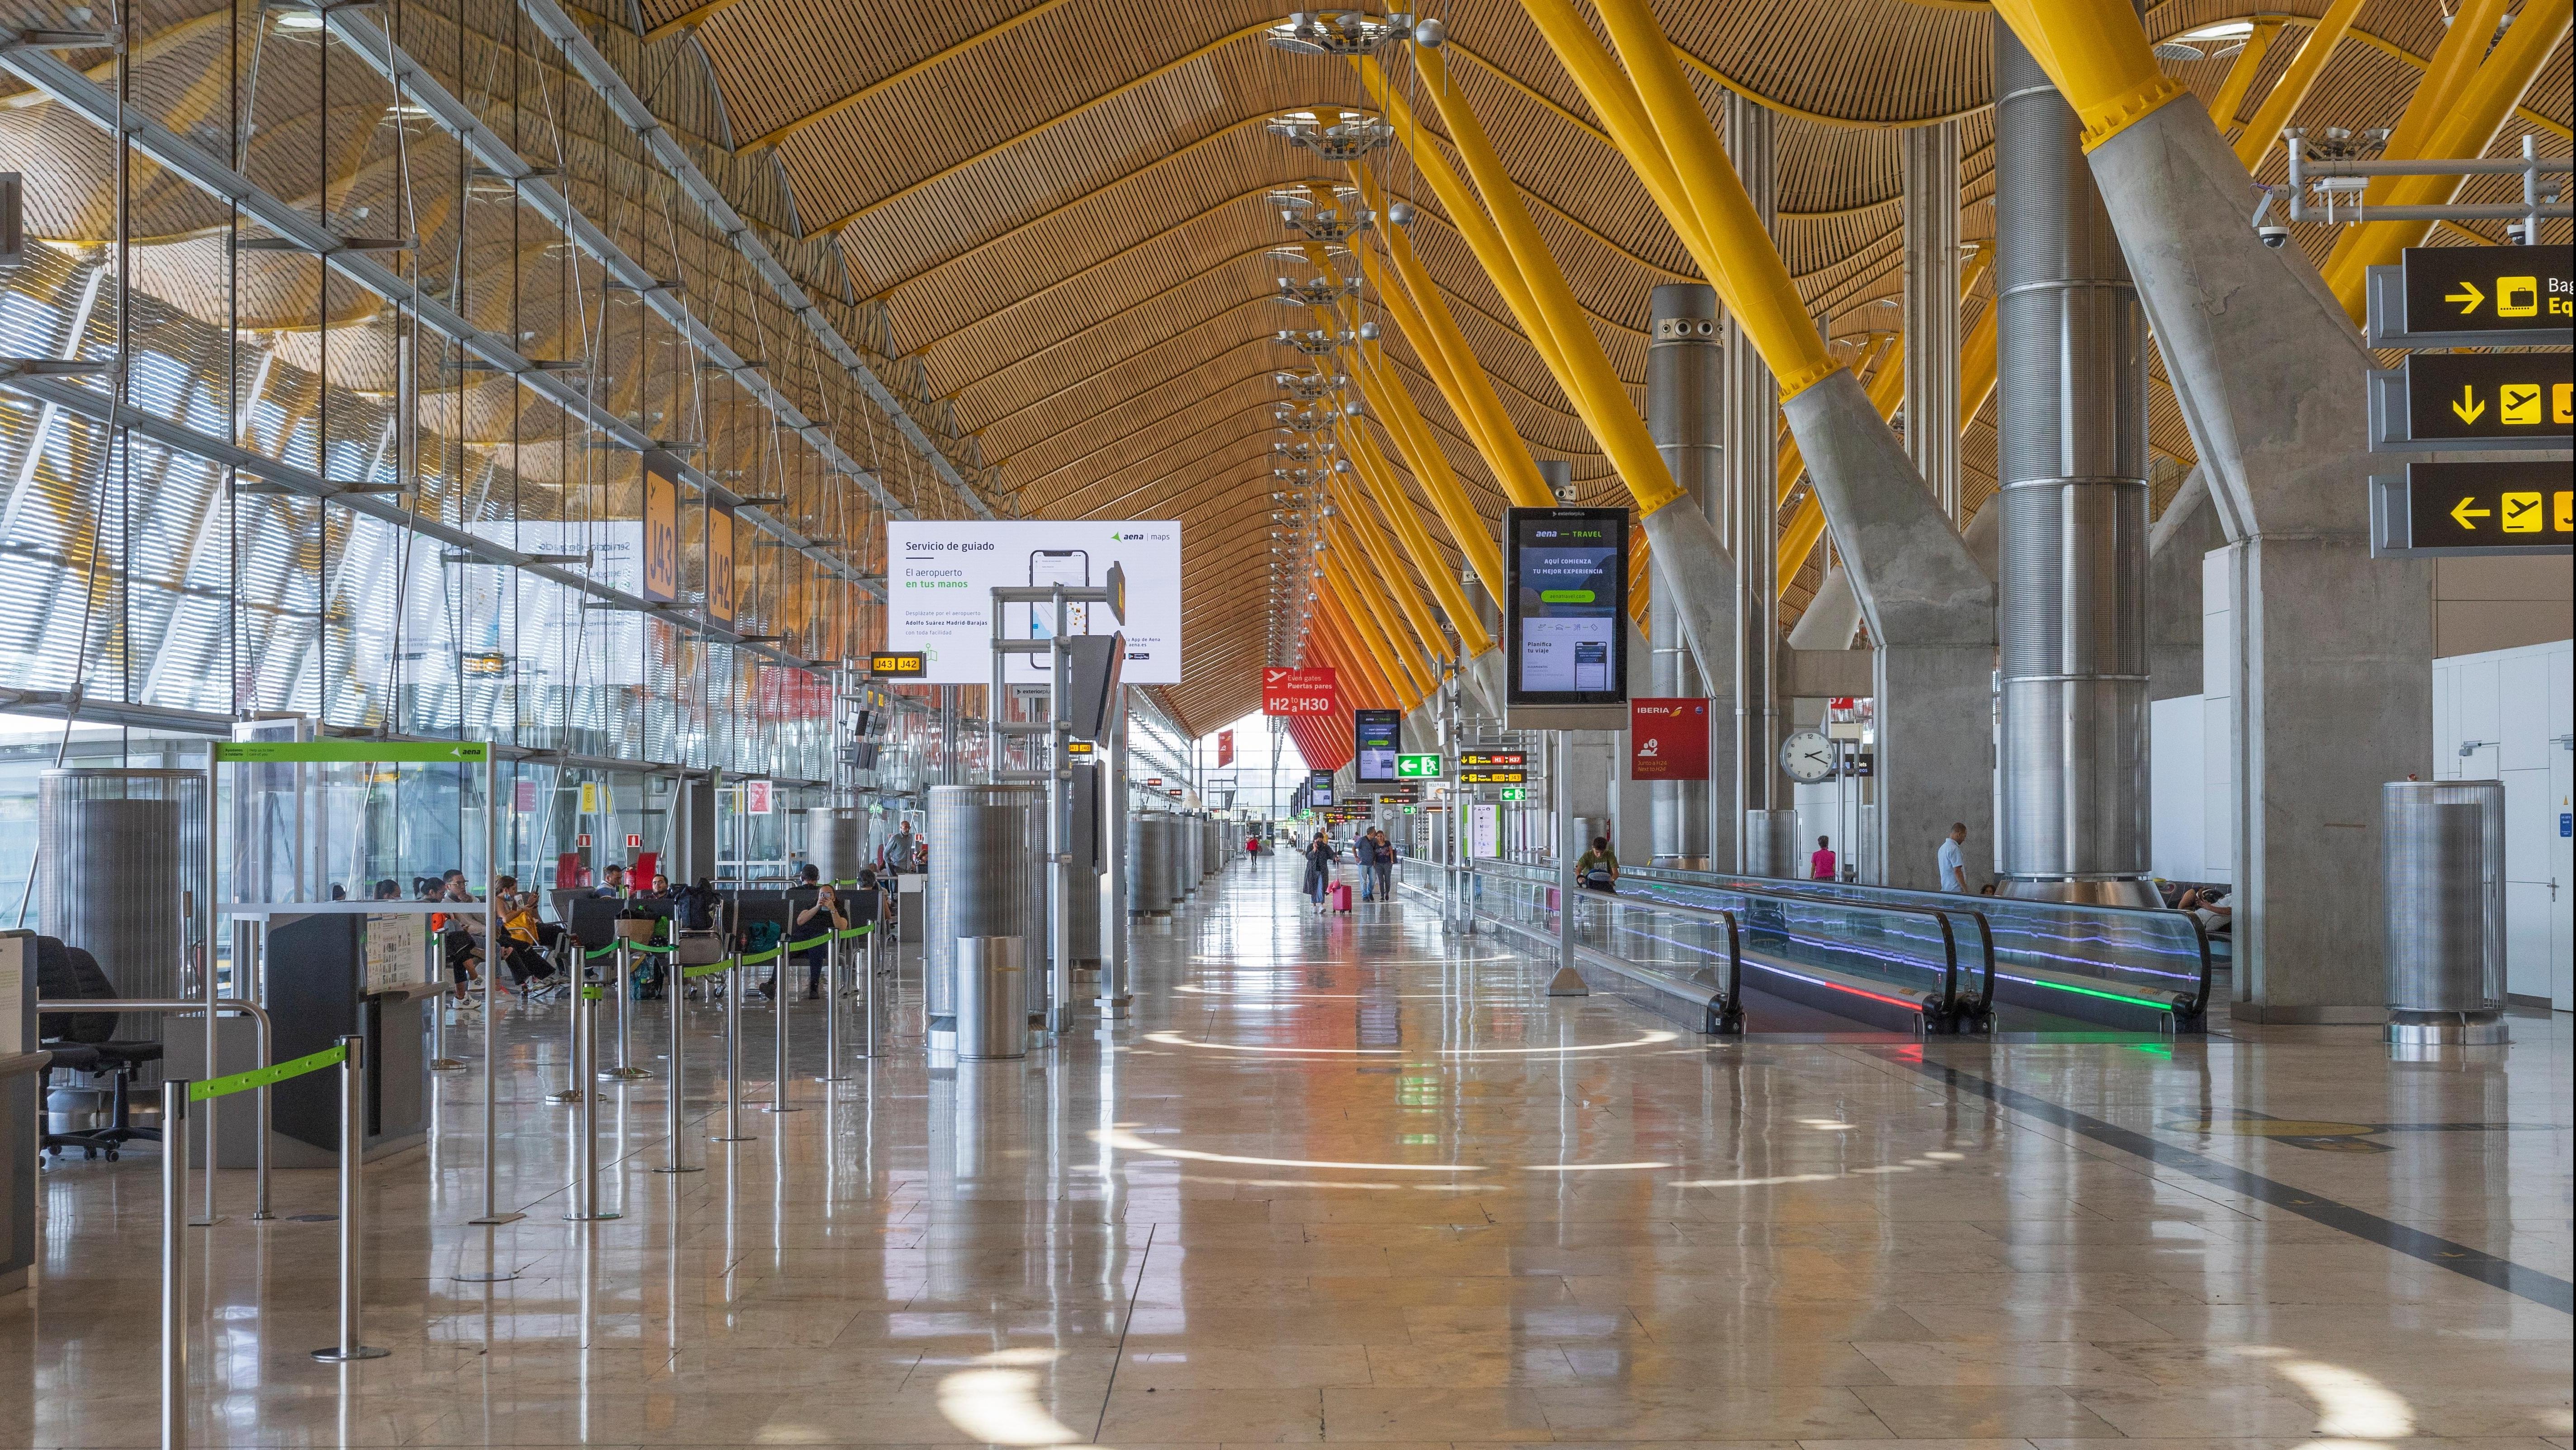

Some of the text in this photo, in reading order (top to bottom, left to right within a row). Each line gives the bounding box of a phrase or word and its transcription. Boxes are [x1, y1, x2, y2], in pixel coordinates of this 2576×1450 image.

[2549, 298, 2573, 317] Eq
[650, 520, 672, 586] J43
[906, 542, 994, 552] Servicio de guiado
[712, 552, 730, 610] J42
[916, 569, 962, 578] aeropuerto
[1270, 698, 1289, 710] H2
[1300, 698, 1329, 710] H30
